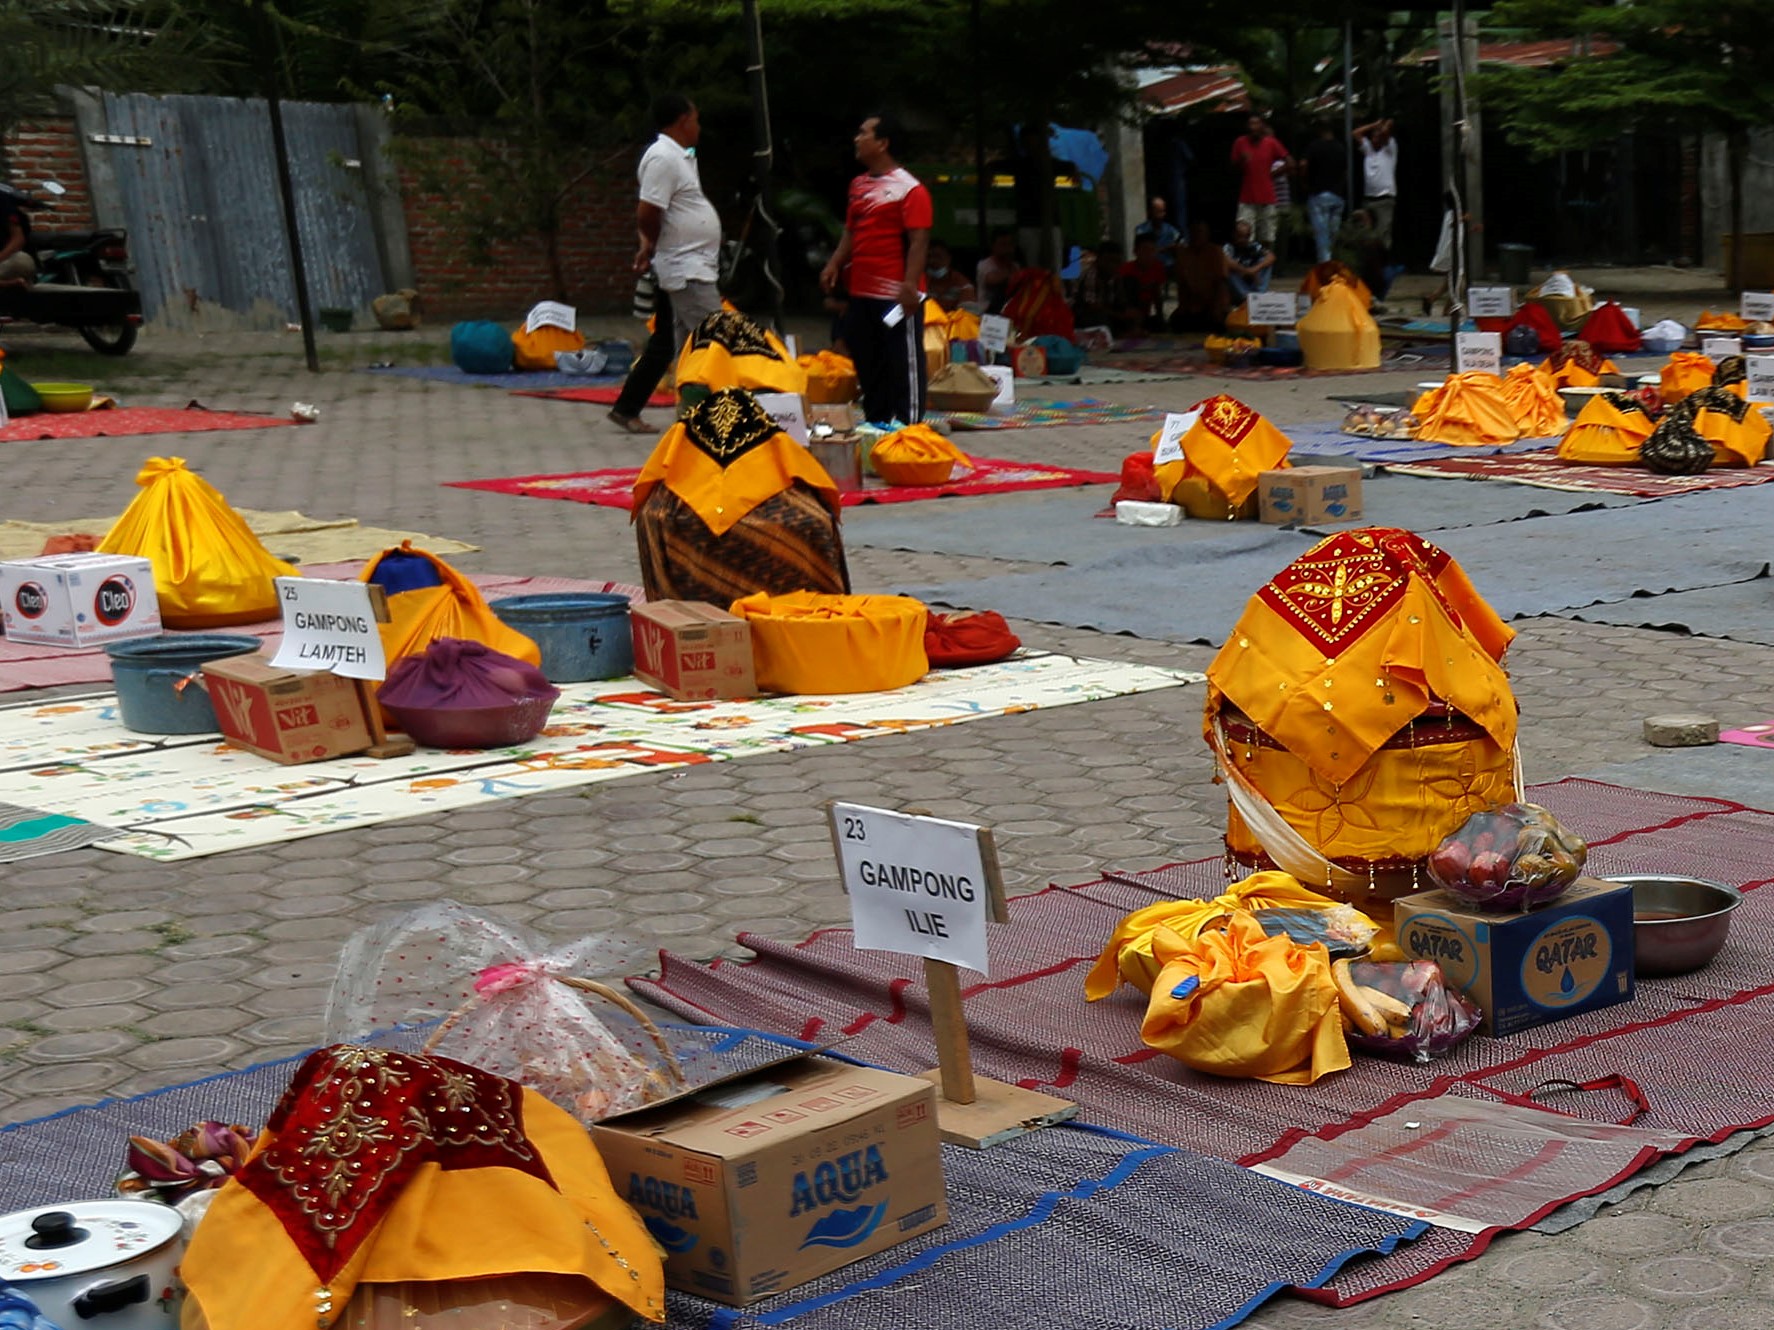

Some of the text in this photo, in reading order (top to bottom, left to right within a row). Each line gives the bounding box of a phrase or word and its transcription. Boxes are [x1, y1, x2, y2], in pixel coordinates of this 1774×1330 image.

[20, 591, 43, 608] Cleo
[102, 591, 129, 612] Cleo
[283, 586, 298, 601] 25
[294, 612, 369, 633] GAMPONG
[299, 643, 367, 664] LAMTEH
[683, 652, 712, 670] Vit
[279, 705, 313, 728] Vit
[844, 818, 866, 841] 23
[860, 860, 975, 903] GAMPONG
[904, 908, 950, 939] ILIE
[1409, 930, 1464, 963] QATAR
[1535, 932, 1599, 974] QATAR
[789, 1144, 888, 1219] AQUA
[627, 1172, 699, 1220] AQUA
